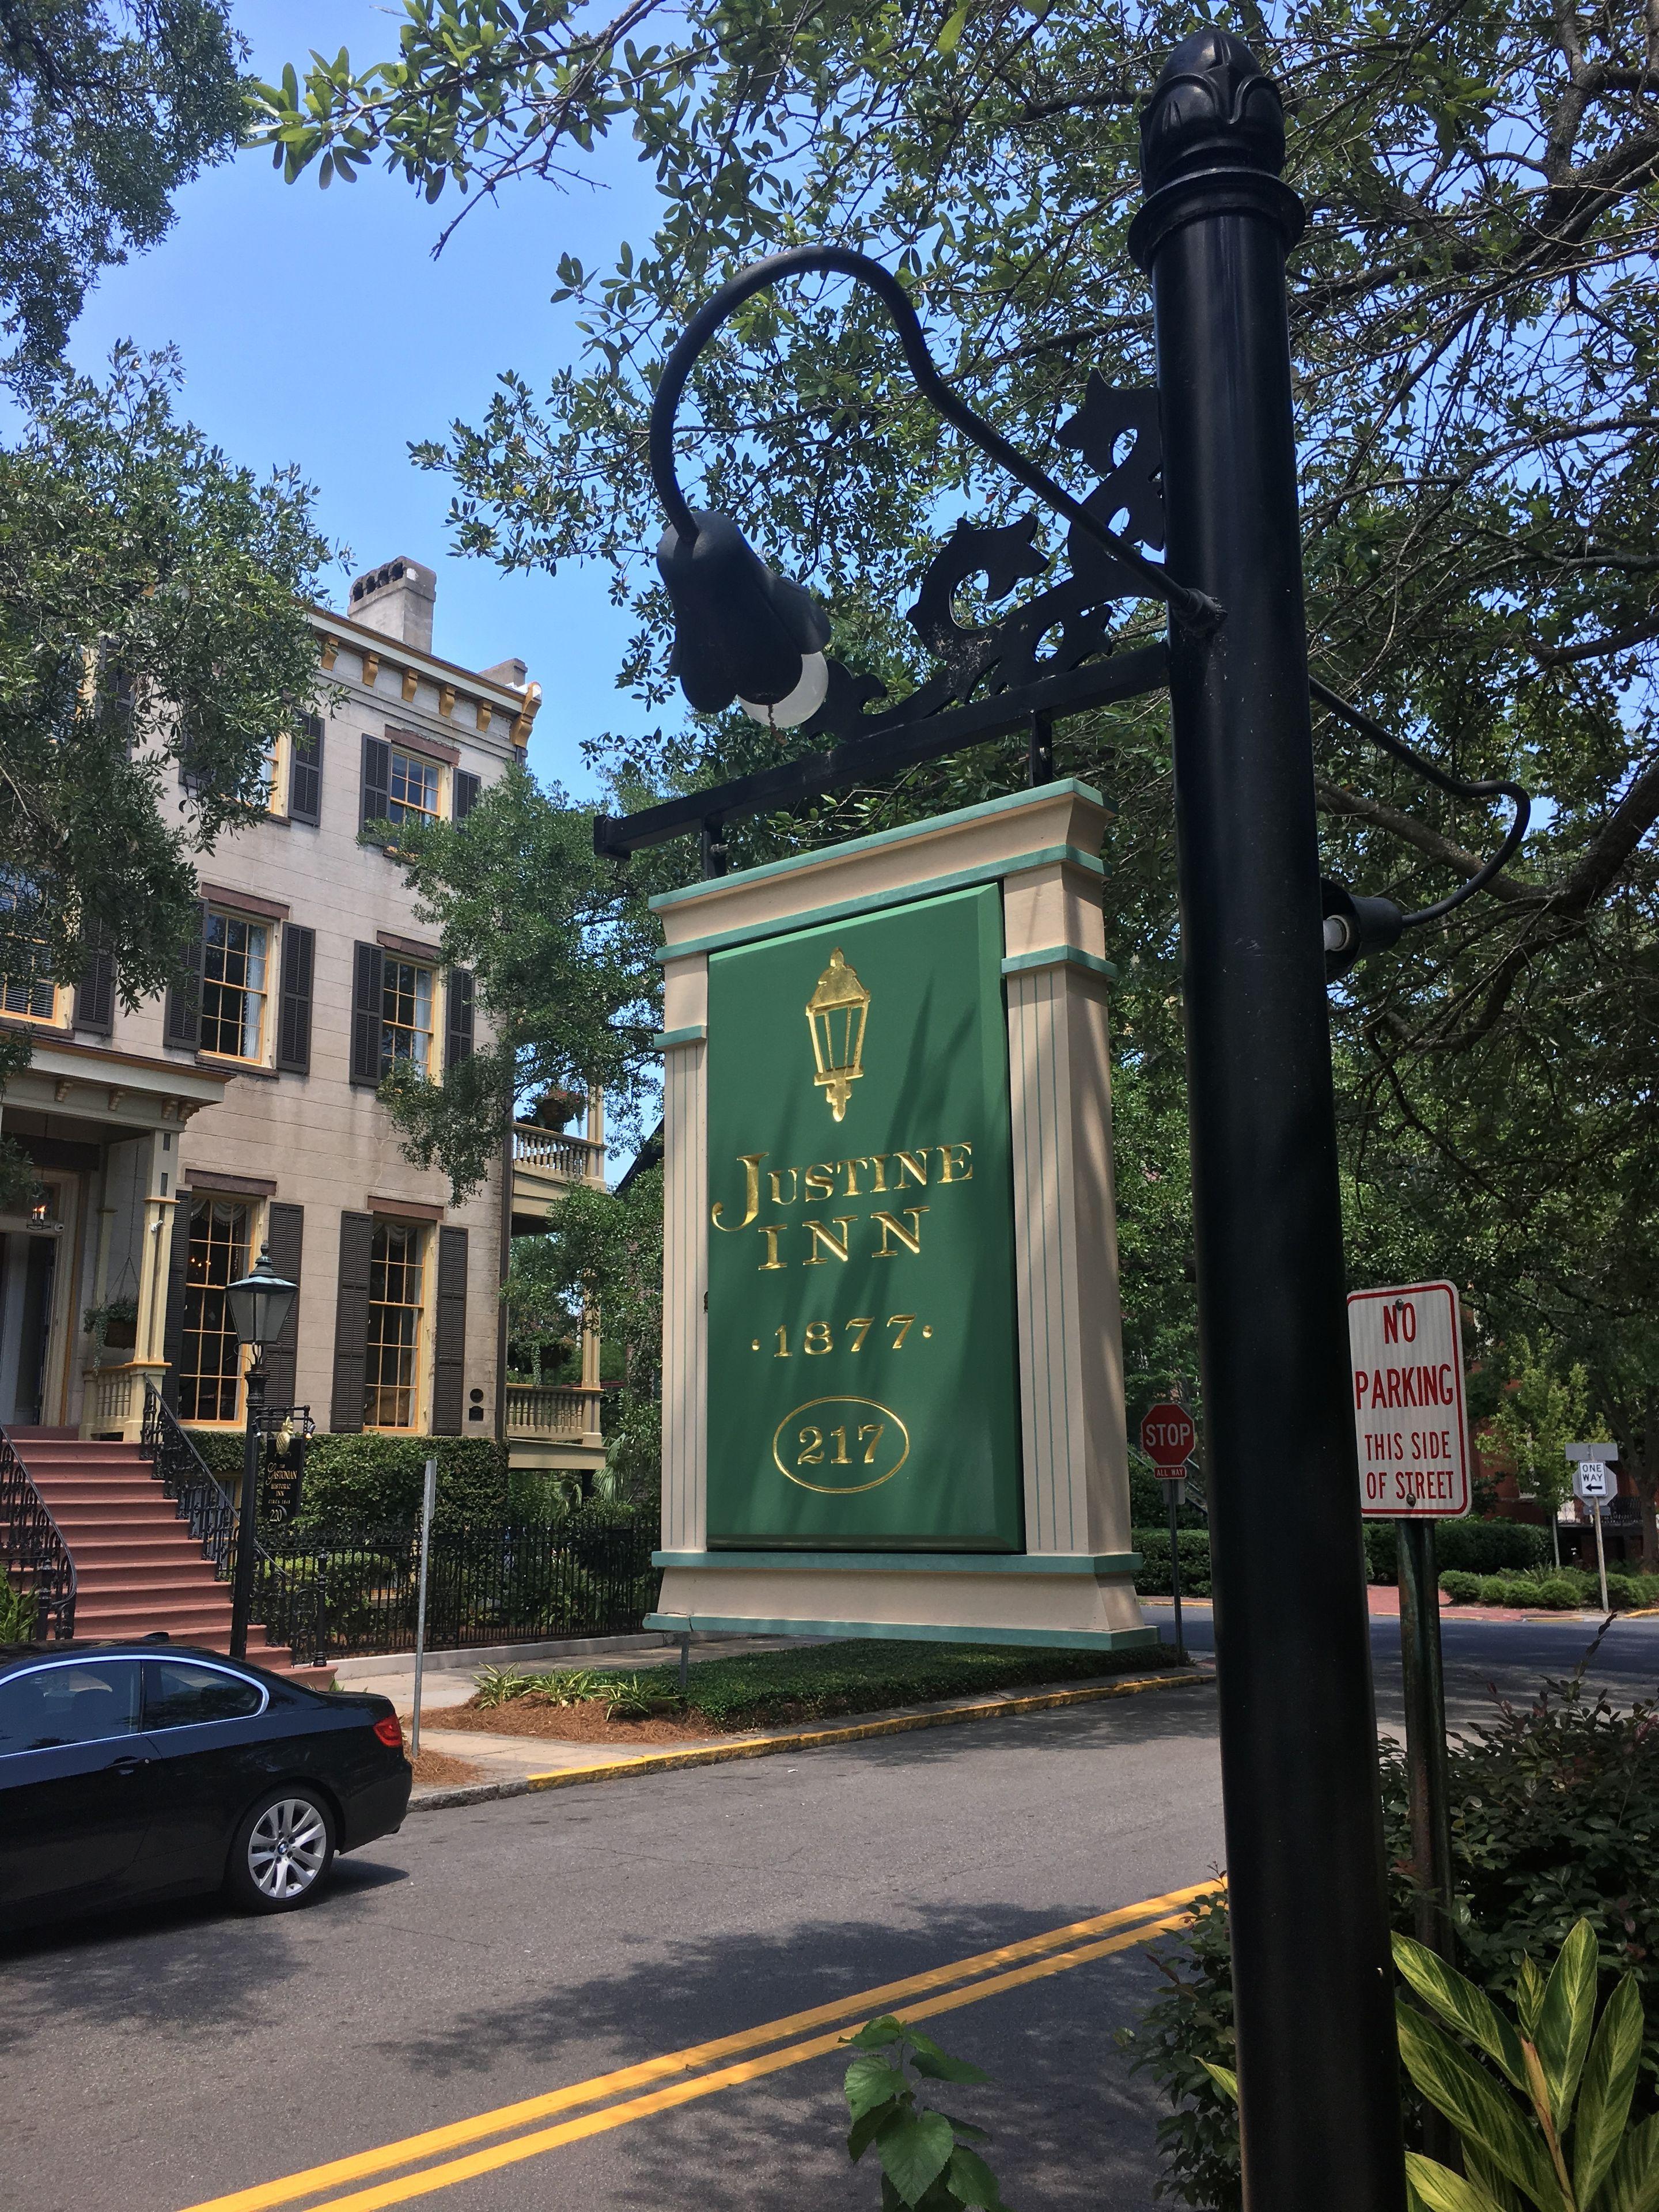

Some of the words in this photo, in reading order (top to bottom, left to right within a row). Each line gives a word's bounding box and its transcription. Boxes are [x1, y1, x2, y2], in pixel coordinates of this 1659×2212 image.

[712, 1142, 974, 1232] JUSTINE
[758, 1206, 930, 1270] INN
[1383, 1302, 1416, 1344] NO
[1355, 1363, 1454, 1410] PARKING
[797, 1424, 885, 1465] 217
[1146, 1423, 1191, 1446] STOP
[1365, 1432, 1403, 1461] THIS
[1411, 1431, 1452, 1460] SIDE
[1582, 1464, 1602, 1472] ONE
[1582, 1474, 1603, 1482] WAY
[1366, 1471, 1387, 1499] OF
[1396, 1471, 1455, 1499] STREET
[270, 1509, 282, 1522] 220
